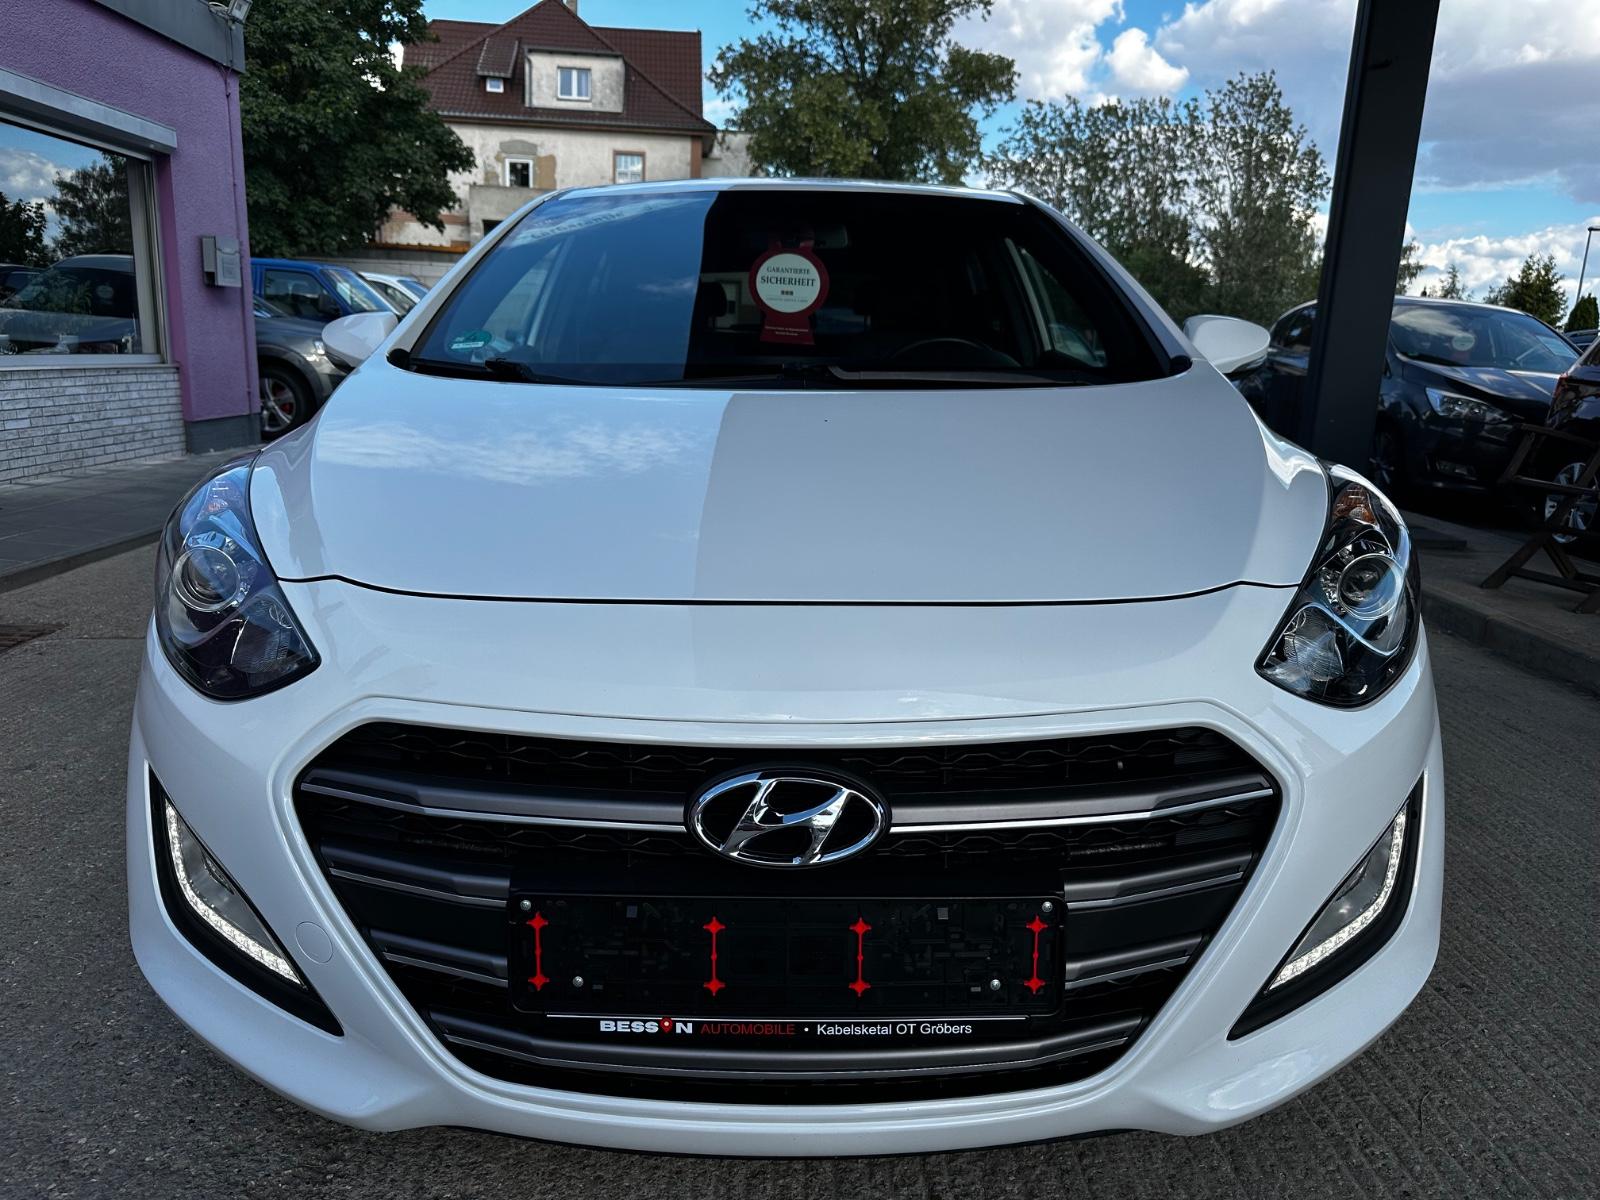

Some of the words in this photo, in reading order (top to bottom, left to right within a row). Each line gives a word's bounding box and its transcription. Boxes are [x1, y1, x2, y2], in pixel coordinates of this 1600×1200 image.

[767, 266, 811, 275] GARANTIERTE
[761, 275, 816, 287] SICHERHEIT
[700, 1023, 795, 1036] AUTOMOBILE
[817, 1023, 892, 1035] Kabelsketal
[896, 1023, 916, 1035] OT
[920, 1022, 972, 1035] Gröbers
